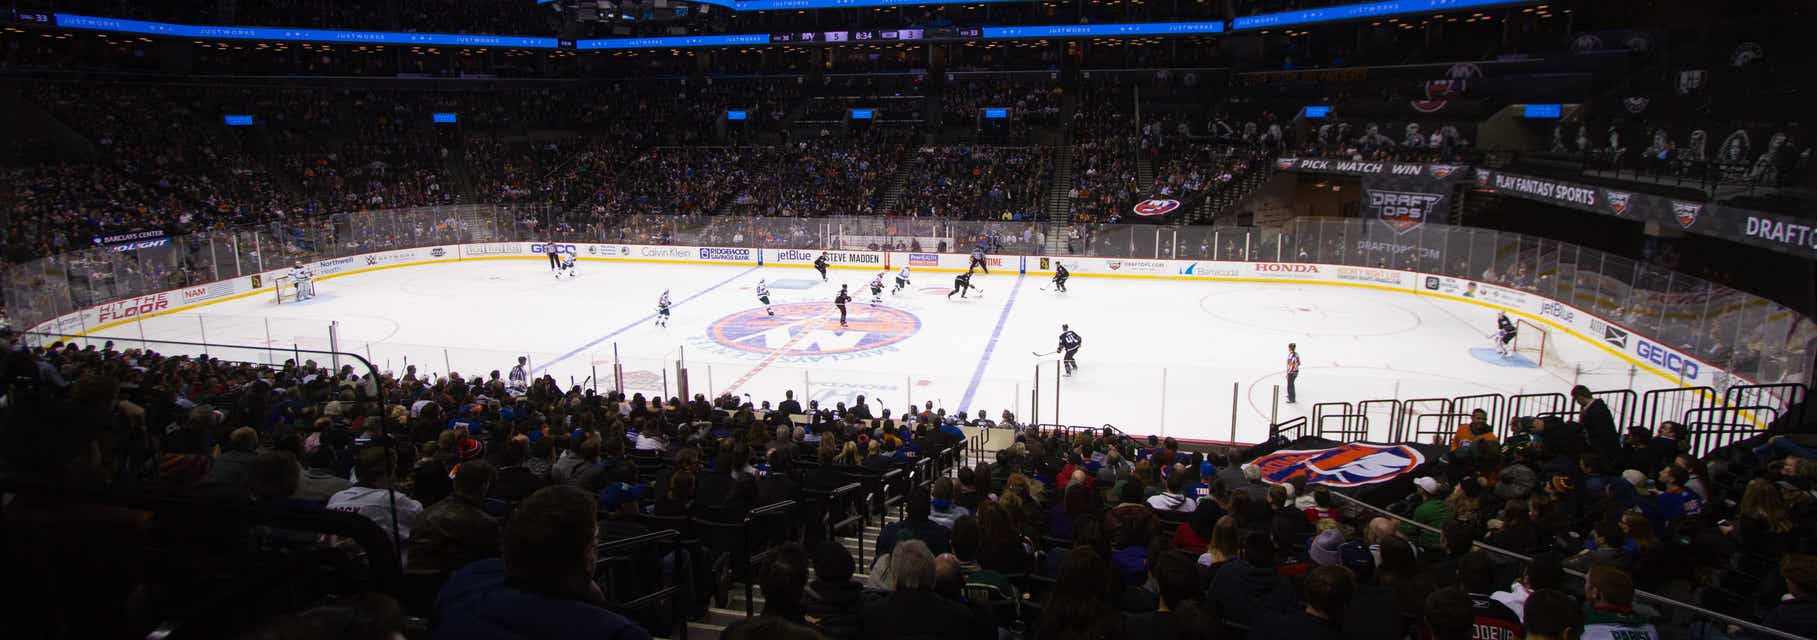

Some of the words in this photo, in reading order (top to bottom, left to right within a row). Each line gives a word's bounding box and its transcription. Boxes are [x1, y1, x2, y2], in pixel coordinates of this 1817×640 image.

[1300, 159, 1329, 170] PICK
[1336, 161, 1383, 173] WATCH
[1391, 164, 1423, 176] WIN
[1495, 174, 1517, 190] PLAY
[1515, 178, 1555, 197] FANTASY
[1555, 184, 1596, 206] SPORTS
[1371, 192, 1438, 207] DRAFT
[1383, 206, 1422, 218] OPS
[104, 233, 137, 243] BARCLAYS
[138, 230, 165, 239] CENTER
[531, 243, 577, 255] GECO
[641, 246, 668, 257] Calvin
[669, 247, 691, 258] Klein
[710, 248, 750, 256] RIDGEWOOD
[777, 250, 812, 262] jetBlue
[825, 253, 848, 263] STEVE
[849, 253, 880, 264] MADDEN
[320, 257, 354, 268] Northwell
[1255, 263, 1319, 273] HONDA
[100, 301, 127, 314] HIT
[133, 293, 168, 306] THE
[99, 300, 169, 323] FLOOR
[1539, 301, 1575, 323] jetBlue
[1636, 339, 1699, 381] GEICO
